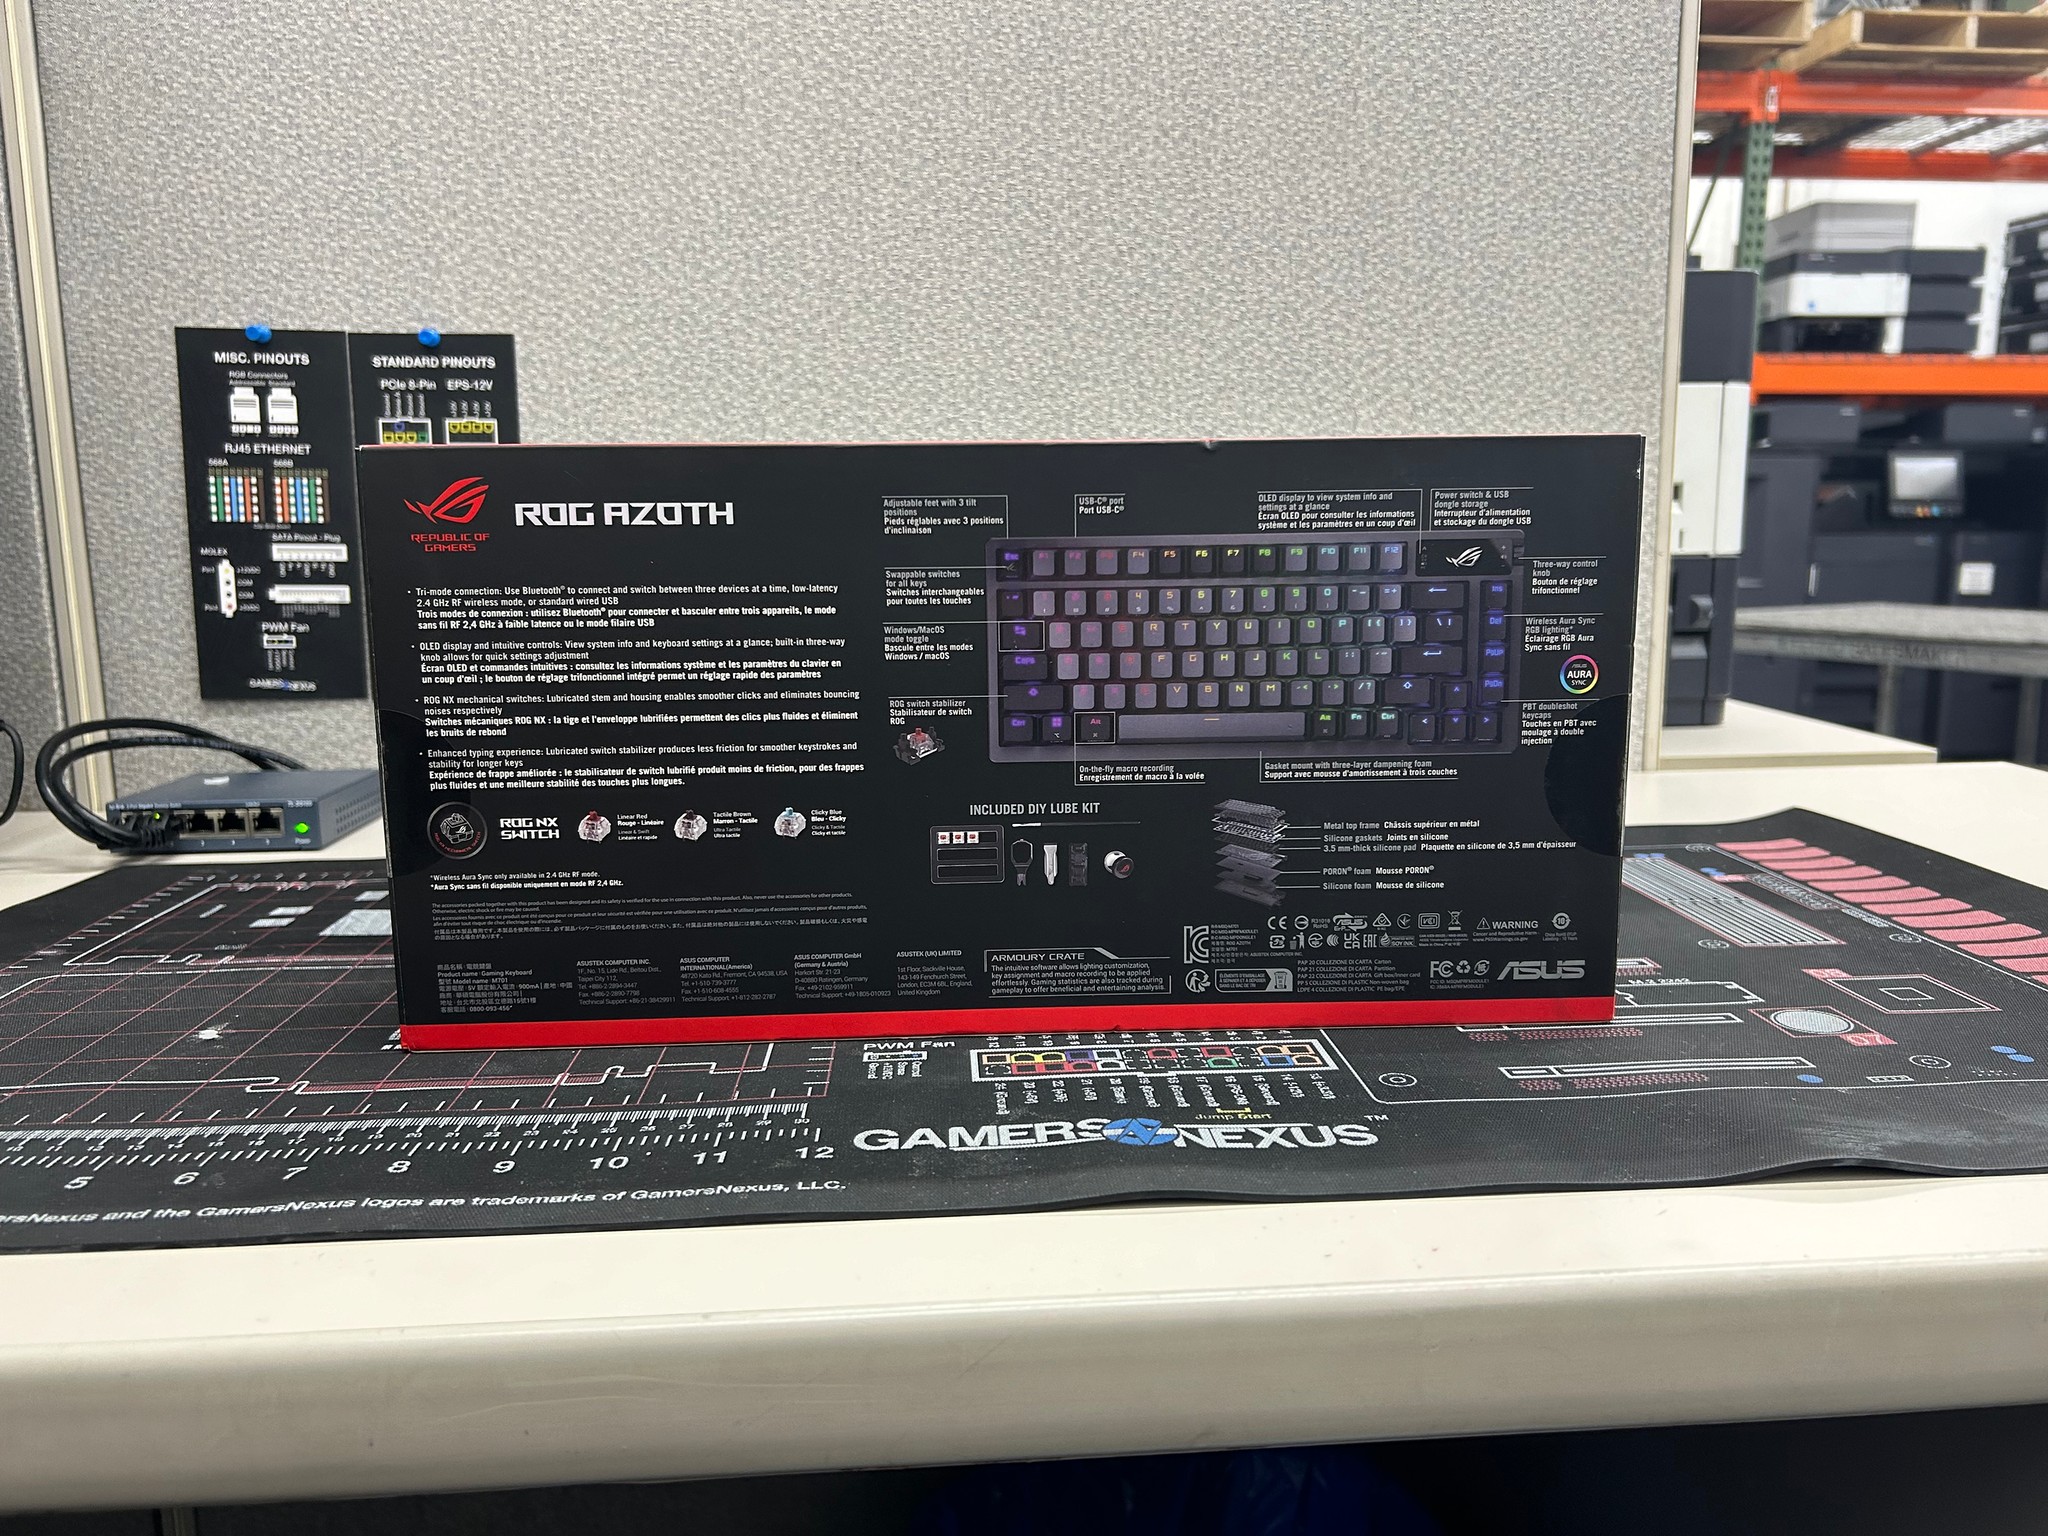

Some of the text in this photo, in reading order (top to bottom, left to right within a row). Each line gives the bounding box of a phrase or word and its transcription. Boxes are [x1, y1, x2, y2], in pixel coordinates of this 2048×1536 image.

[214, 352, 310, 365] MISC. PINOUTS
[372, 356, 496, 369] STANDARD PINOUTS
[380, 379, 437, 391] PCIe 8-Pin
[446, 379, 493, 391] EPS-12V
[224, 443, 311, 455] RJ45 ETHERNET
[1459, 491, 1483, 499] switch
[884, 499, 922, 509] Adjustable
[924, 499, 938, 507] feet
[940, 499, 956, 507] with
[1108, 497, 1124, 506] port
[1435, 500, 1488, 509] dongle storage
[515, 501, 734, 526] ROG AZOTH
[884, 508, 917, 517] positions
[1079, 506, 1094, 514] Port
[411, 533, 490, 543] REPUBLIC OF
[201, 547, 228, 556] MOLEX
[425, 543, 476, 552] GAMERS
[1227, 549, 1240, 557] F7
[1164, 550, 1176, 558] F5
[1195, 550, 1208, 558] F6
[1533, 560, 1570, 570] Three-way
[416, 587, 451, 595] Tri-mode
[454, 587, 501, 595] connection:
[504, 587, 519, 595] Use
[567, 586, 575, 594] to
[577, 586, 610, 594] connect
[612, 586, 627, 594] and
[629, 586, 656, 594] switch
[658, 585, 692, 594] between
[694, 585, 715, 594] three
[718, 585, 749, 593] devices
[751, 585, 759, 593] at
[768, 585, 789, 595] time,
[791, 584, 838, 595] low-latency
[416, 599, 430, 607] 2.4
[432, 599, 449, 607] GHz
[451, 598, 461, 607] RF
[463, 598, 498, 606] wireless
[500, 598, 525, 608] mode,
[538, 597, 574, 606] standard
[576, 597, 599, 605] wired
[601, 597, 619, 605] USB
[261, 622, 310, 633] PWM Fan
[420, 651, 589, 663] knob allows for quick settings adjustment
[1567, 670, 1592, 679] AURA
[426, 728, 507, 737] les bruits de rebond
[428, 759, 524, 770] stability for longer keys
[970, 802, 1100, 815] INCLUDED DIY LUBE KIT
[500, 817, 558, 828] ROG NX
[1323, 822, 1343, 830] Metal
[1345, 822, 1357, 831] top
[1383, 821, 1411, 829] Châssis
[1413, 821, 1446, 830] supérieur
[500, 829, 560, 840] SWITCH
[494, 873, 507, 881] only
[1492, 920, 1539, 929] WARNING
[1049, 952, 1085, 960] CRATE
[1497, 960, 1586, 980] ASUS
[863, 1041, 956, 1051] PWM Fan
[853, 1118, 1379, 1151] GAMERS NEXUS
[693, 1150, 728, 1165] 11
[796, 1146, 835, 1159] 12
[387, 1160, 411, 1173] 8
[492, 1160, 516, 1174] 9
[589, 1156, 629, 1169] 10
[283, 1166, 308, 1179] 7
[64, 1176, 95, 1190] 5
[173, 1172, 199, 1185] 6
[102, 1210, 150, 1221] and
[153, 1207, 190, 1219] the
[199, 1200, 354, 1217] GamersNexus
[360, 1197, 424, 1209] logos
[429, 1197, 465, 1206] are
[471, 1193, 597, 1206] trademarks
[602, 1190, 626, 1201] of
[797, 1181, 847, 1190] LLC.
